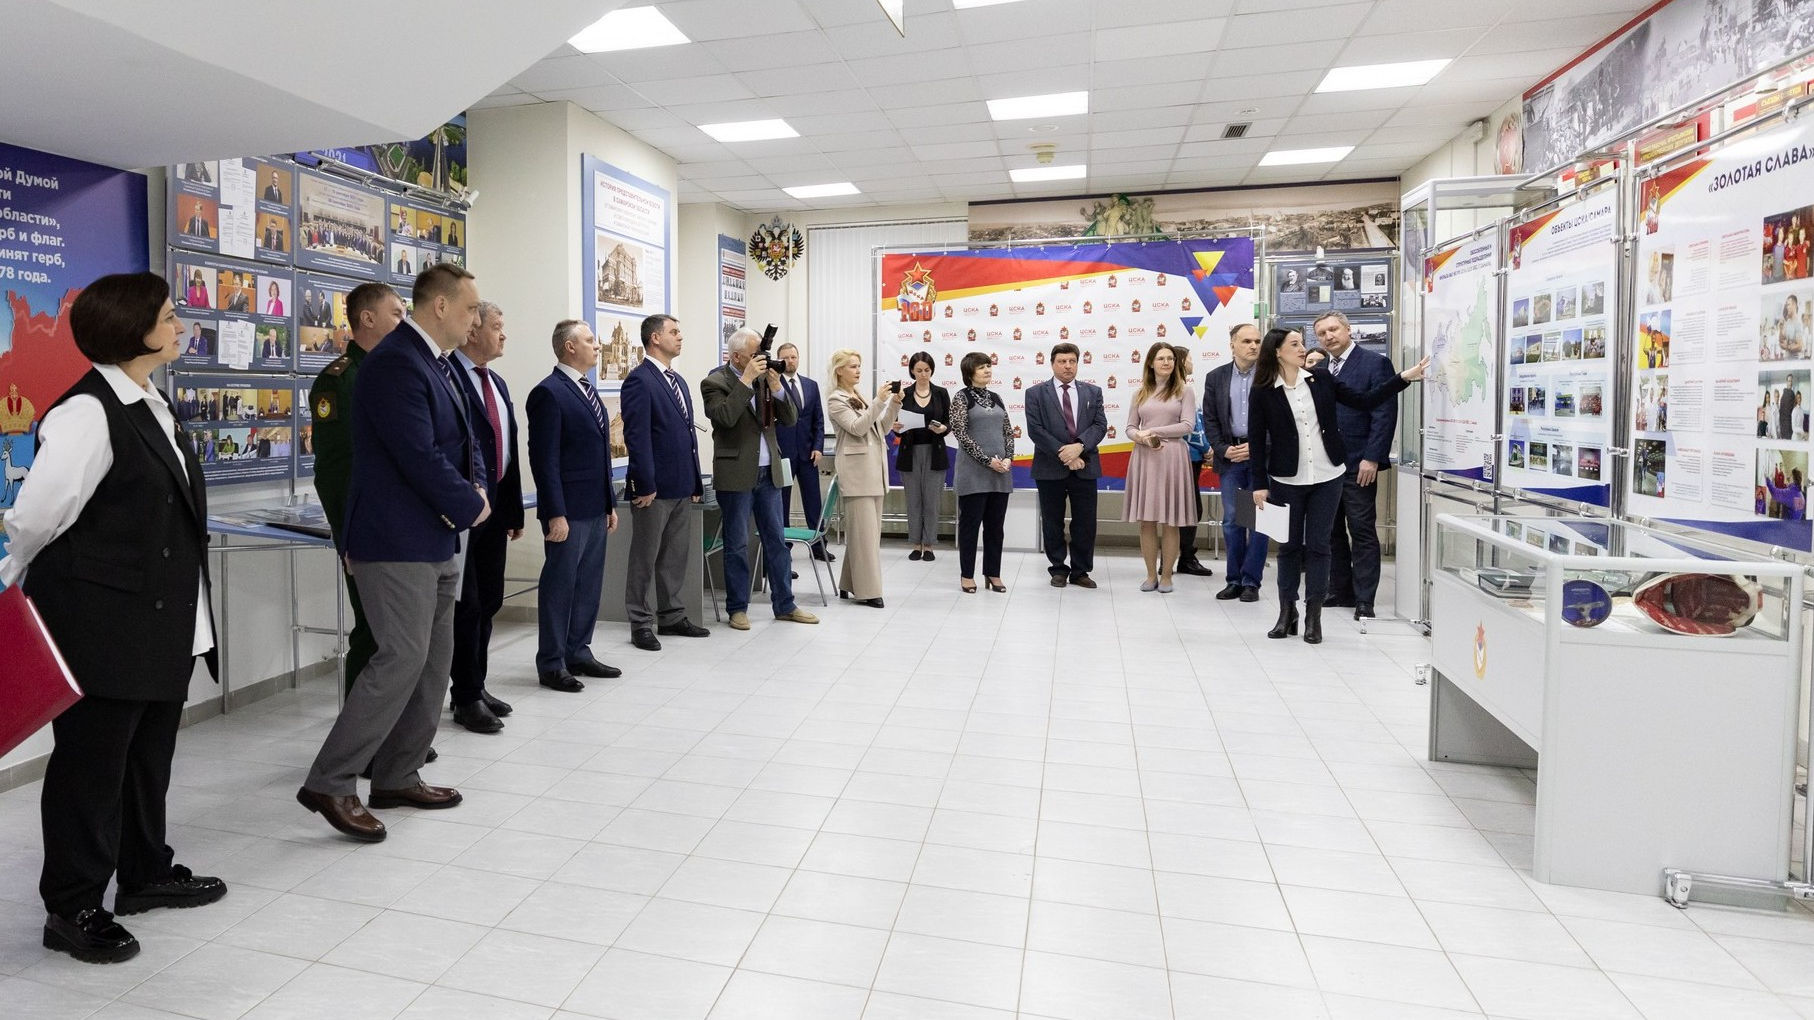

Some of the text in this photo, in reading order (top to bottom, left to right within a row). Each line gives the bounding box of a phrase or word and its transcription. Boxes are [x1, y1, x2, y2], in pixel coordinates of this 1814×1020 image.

[1708, 144, 1814, 193] «ЗОЛОТАЯ СЛАВА»
[16, 170, 59, 190] Думой
[19, 231, 28, 242] и
[31, 231, 65, 247] флаг.
[32, 253, 65, 268] герб,
[18, 270, 52, 284] года.
